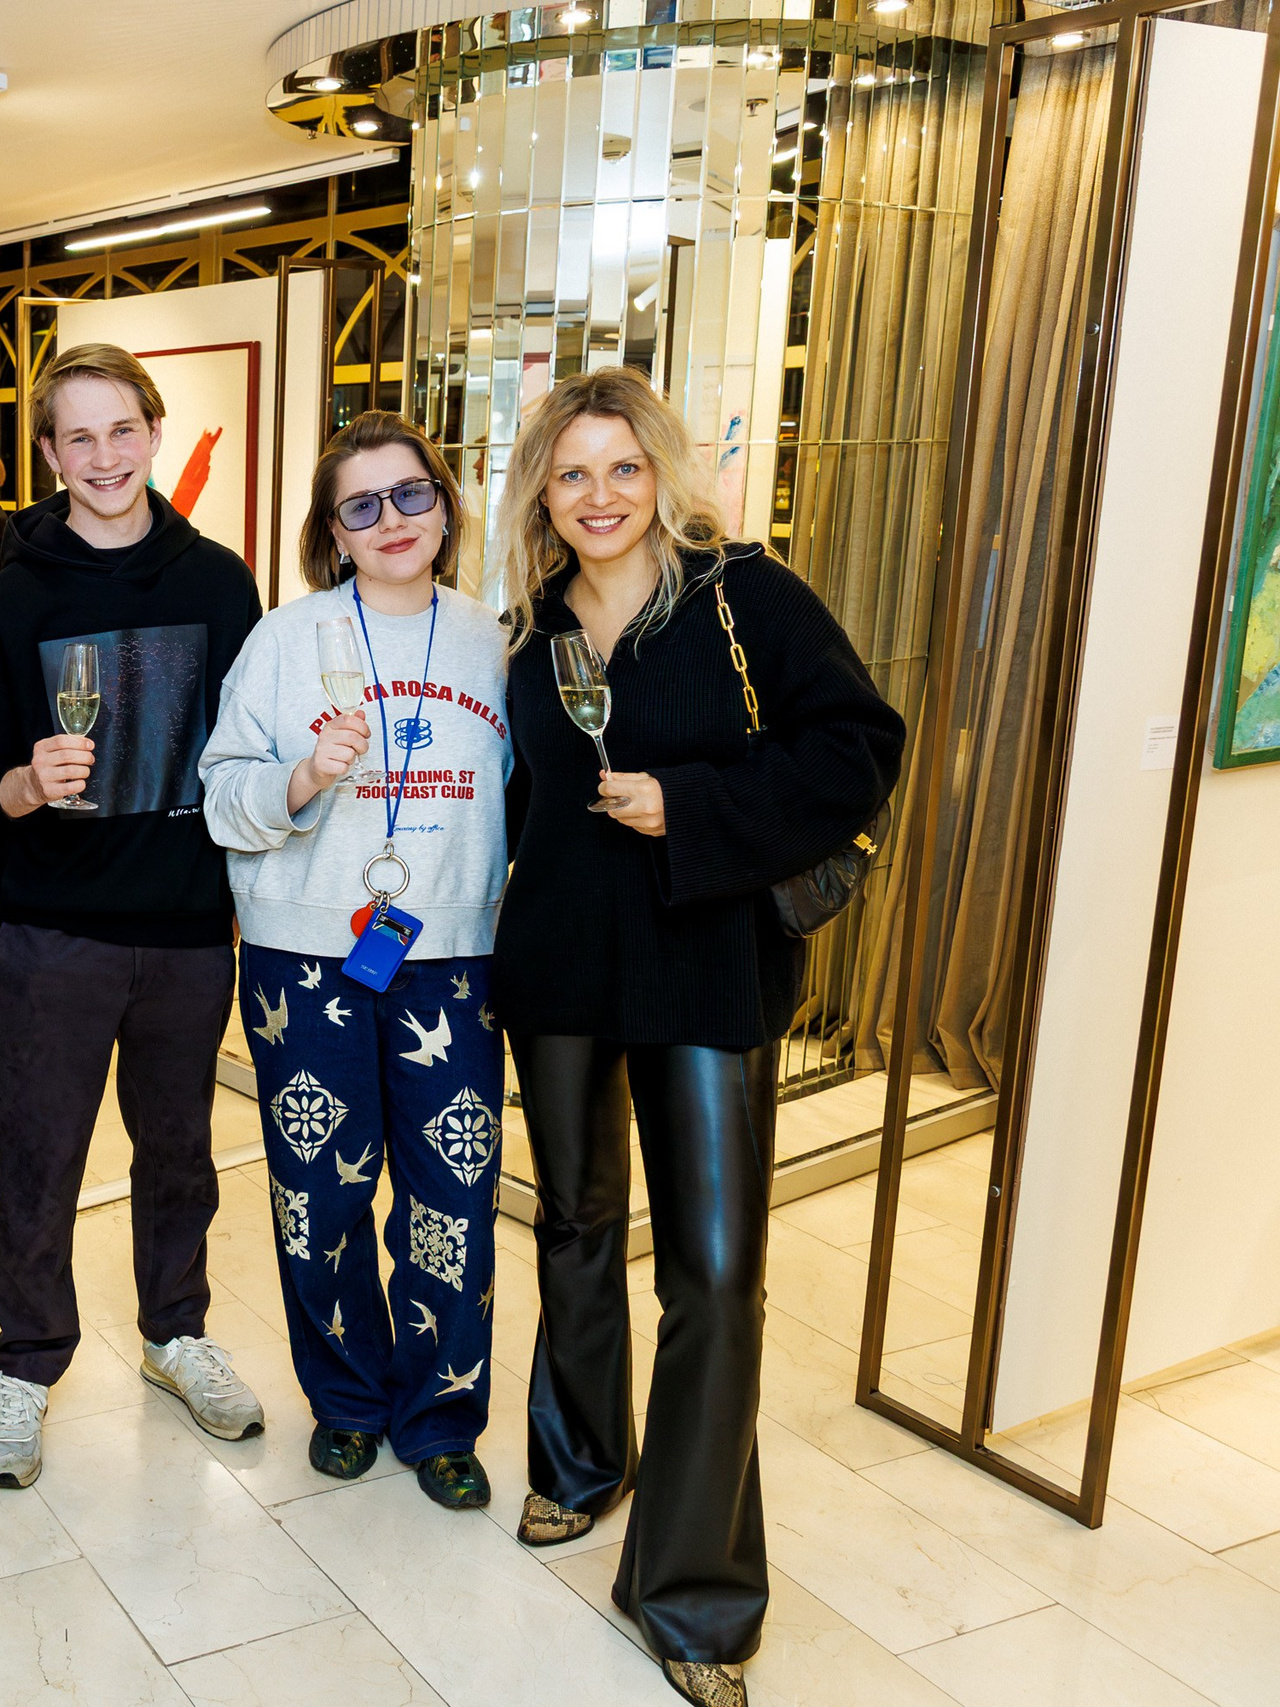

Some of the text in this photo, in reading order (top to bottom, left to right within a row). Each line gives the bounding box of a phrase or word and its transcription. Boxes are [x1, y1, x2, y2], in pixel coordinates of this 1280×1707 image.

[391, 680, 453, 702] ROSA
[457, 691, 508, 741] HILLS
[385, 770, 456, 784] BUILDING,
[458, 770, 475, 784] ST
[355, 785, 475, 800] 75004 EAST CLUB
[418, 823, 427, 833] by
